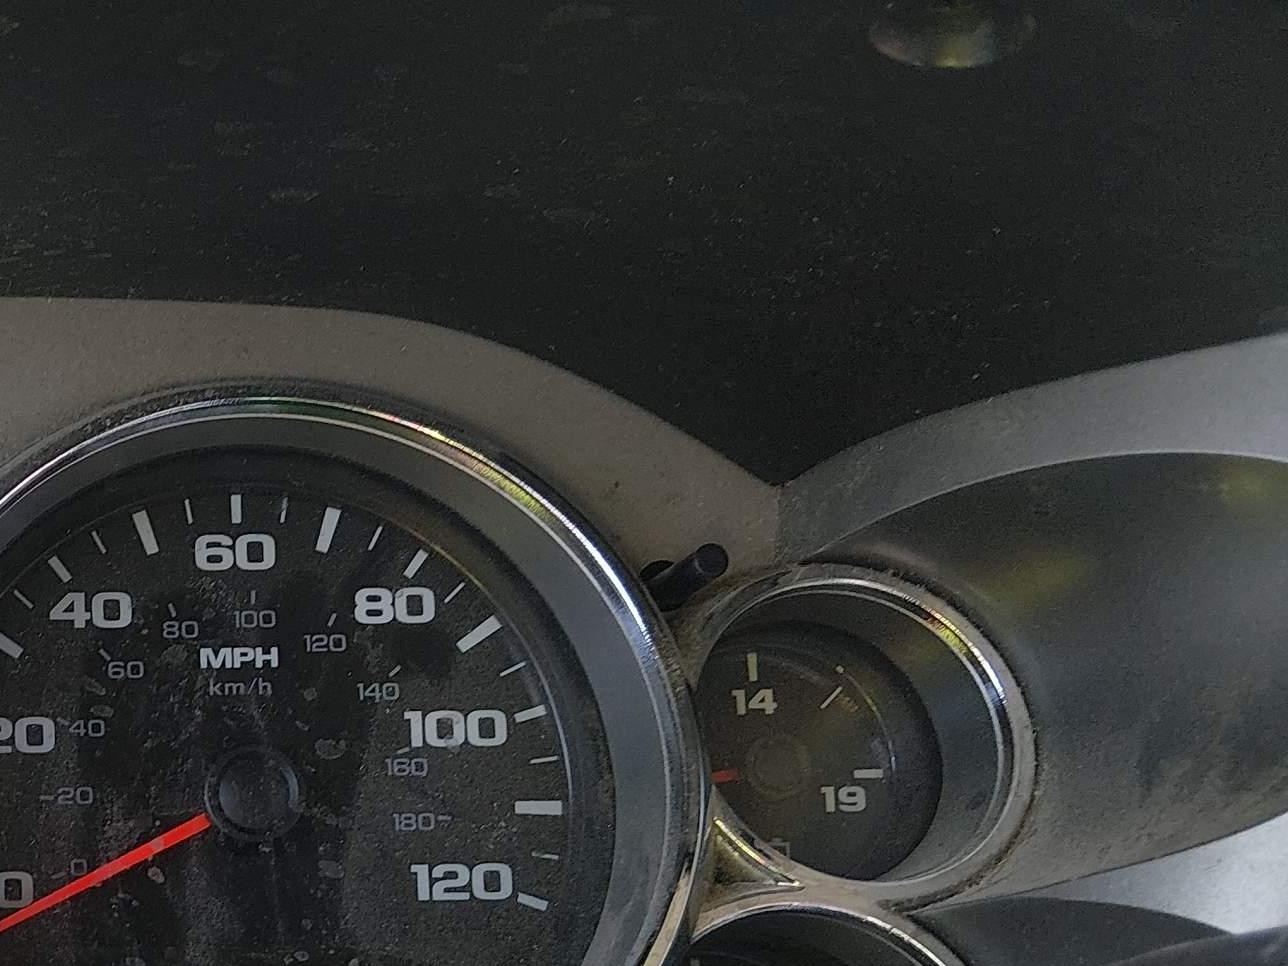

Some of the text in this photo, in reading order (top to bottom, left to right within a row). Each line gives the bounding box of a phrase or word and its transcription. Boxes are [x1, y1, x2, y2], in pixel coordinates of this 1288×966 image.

[194, 533, 277, 571] 60
[49, 591, 133, 629] 40
[353, 586, 436, 625] 80
[233, 608, 277, 629] 100
[162, 620, 200, 639] 80
[303, 634, 347, 653] 120
[199, 646, 280, 669] MPH
[106, 660, 145, 680] 60
[209, 677, 273, 697] km/h
[357, 681, 400, 701] 140
[731, 689, 778, 714] 14
[68, 719, 106, 738] 40
[404, 709, 508, 748] 100
[385, 758, 428, 777] 160
[54, 786, 94, 806] 20
[821, 787, 867, 812] 19
[393, 812, 436, 831] 180
[411, 862, 513, 901] 120
